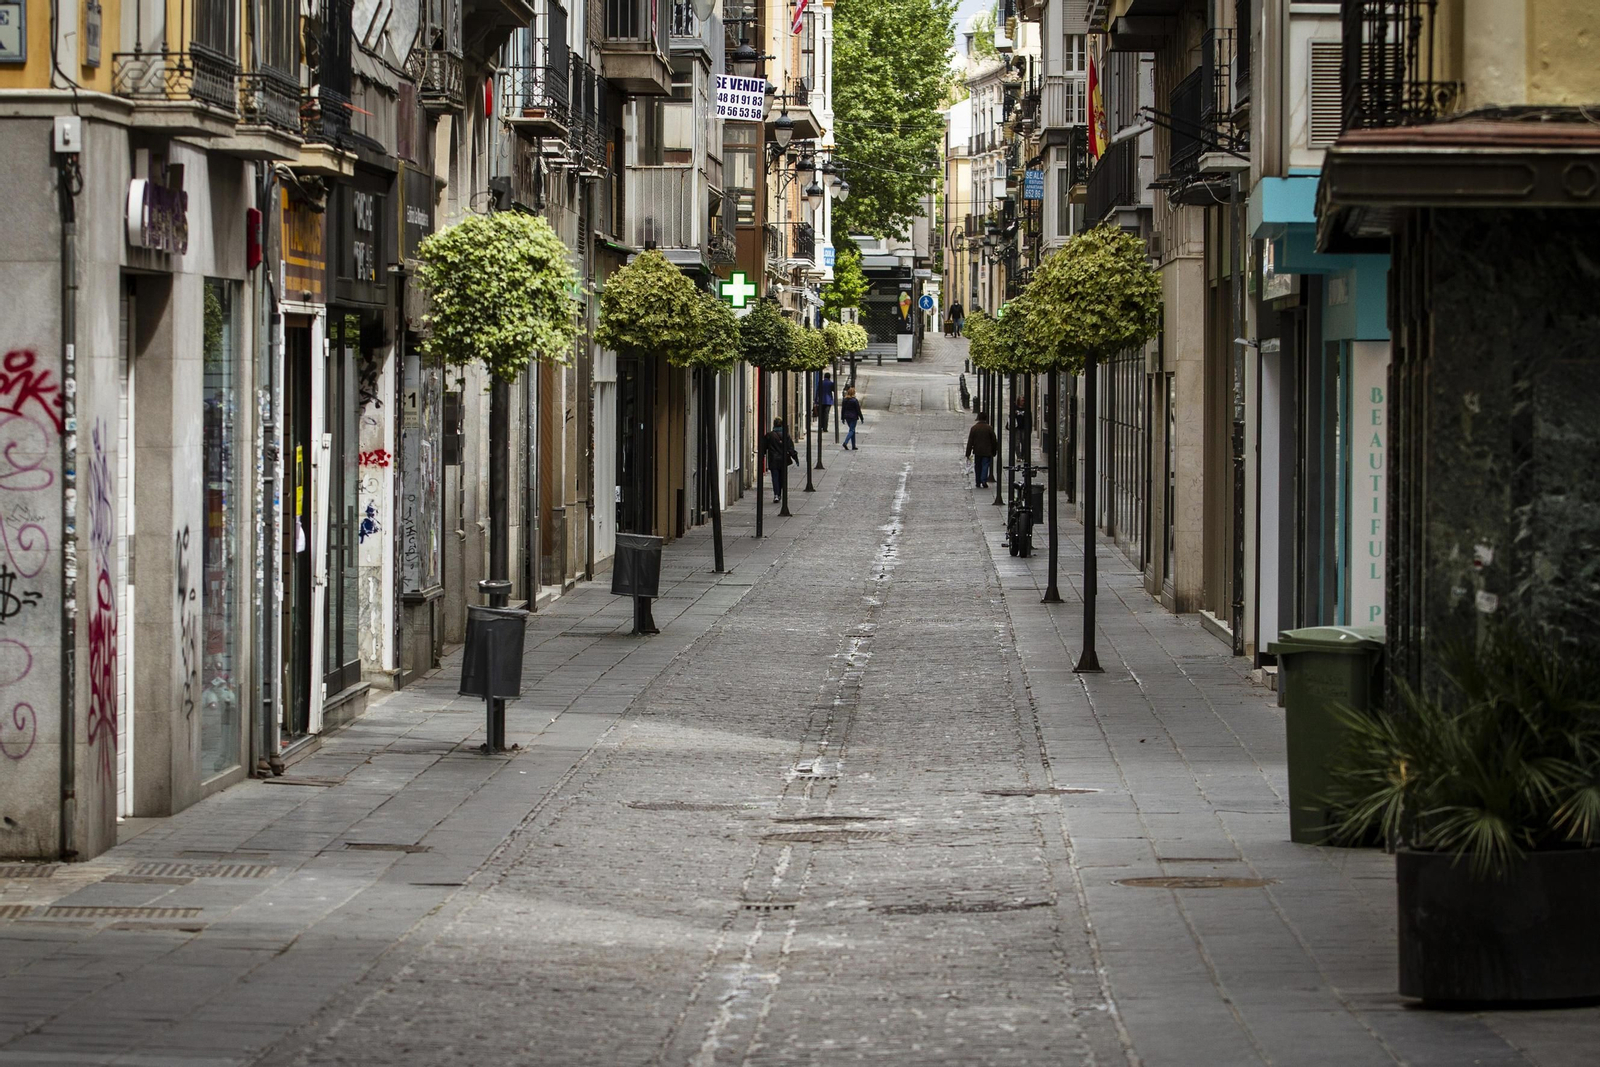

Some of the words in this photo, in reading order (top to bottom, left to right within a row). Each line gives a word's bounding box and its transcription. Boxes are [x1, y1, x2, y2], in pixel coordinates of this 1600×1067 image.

[716, 76, 728, 89] SE
[730, 78, 765, 93] VENDE
[716, 92, 728, 103] 48
[730, 94, 739, 104] 81
[741, 95, 750, 105] 91
[752, 95, 763, 106] 83
[727, 106, 738, 117] 56
[739, 107, 750, 118] 53
[751, 108, 762, 119] 58
[1368, 386, 1384, 580] BEAUTIFUL
[1368, 605, 1382, 622] P
